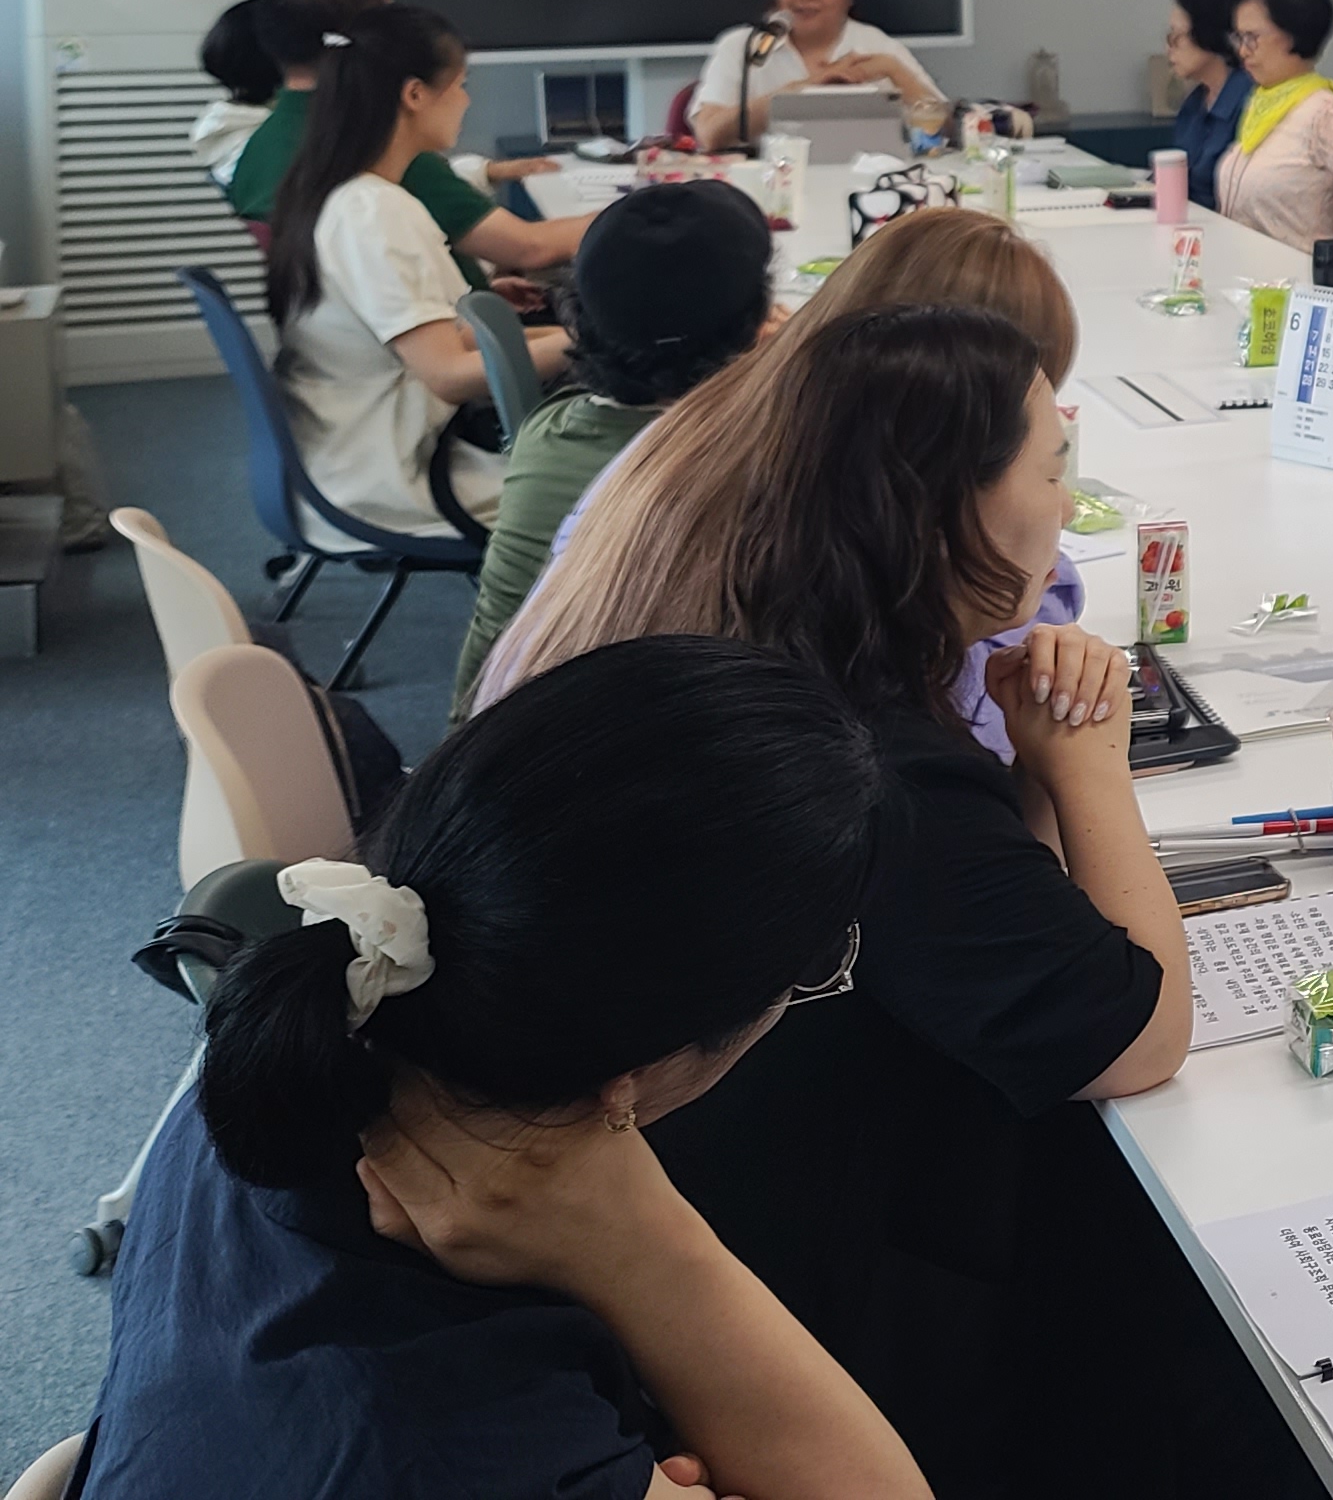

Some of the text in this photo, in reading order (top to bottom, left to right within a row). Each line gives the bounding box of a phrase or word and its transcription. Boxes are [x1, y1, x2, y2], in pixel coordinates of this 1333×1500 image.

[1289, 312, 1301, 331] 6
[1329, 318, 1333, 329] 1
[1322, 348, 1331, 358] 15
[1318, 362, 1329, 374] 22
[1315, 377, 1326, 388] 29
[1144, 579, 1181, 592] 과원
[1280, 1228, 1304, 1249] 더하여
[1295, 1250, 1329, 1283] 사회구조적
